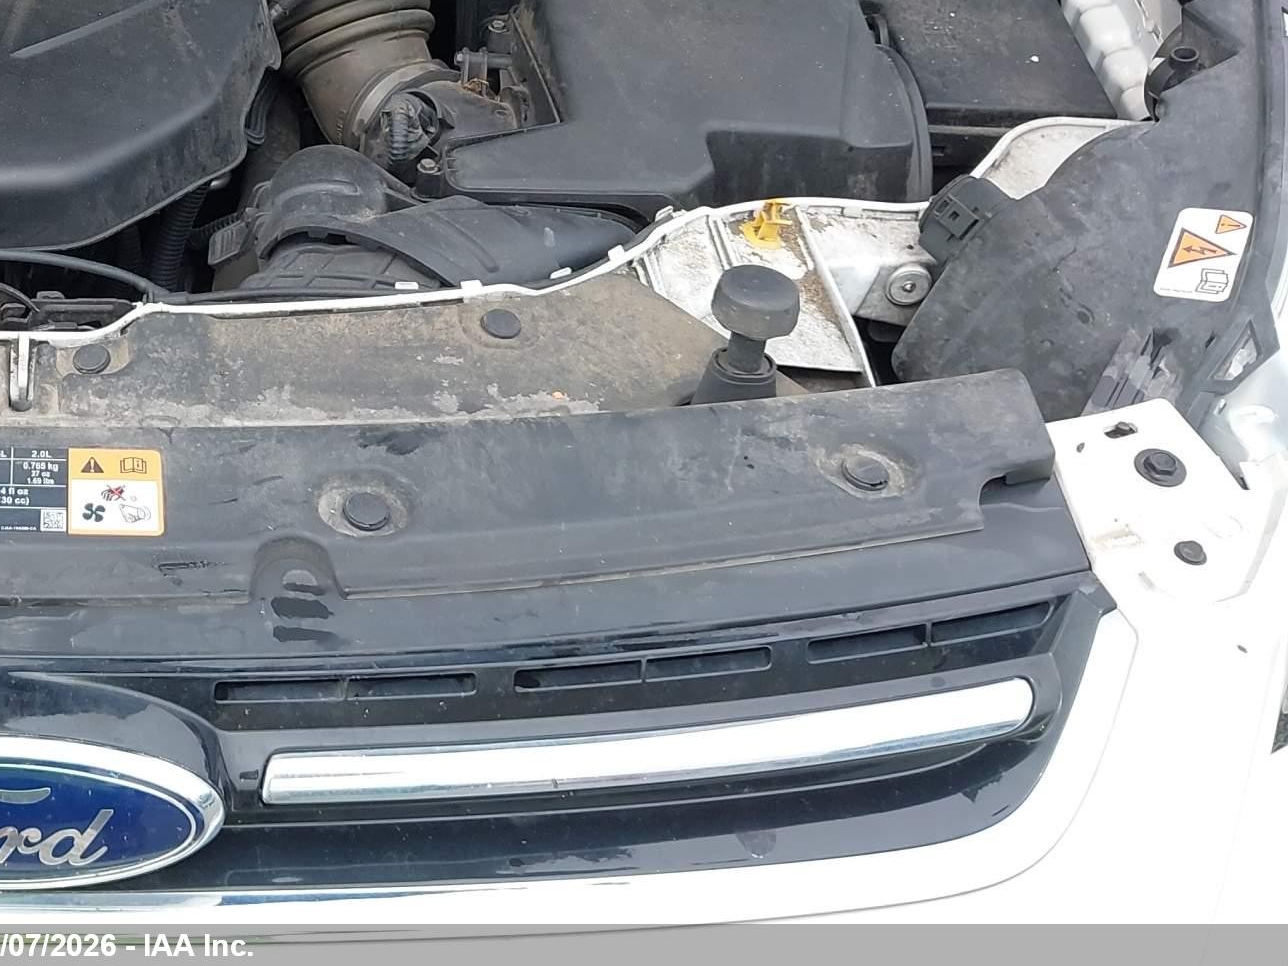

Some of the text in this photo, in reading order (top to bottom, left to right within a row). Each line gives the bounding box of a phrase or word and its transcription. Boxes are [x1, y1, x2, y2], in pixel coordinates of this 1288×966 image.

[31, 450, 52, 458] 2.0L
[22, 461, 59, 472] 0.765 kg
[14, 496, 30, 506] cc)
